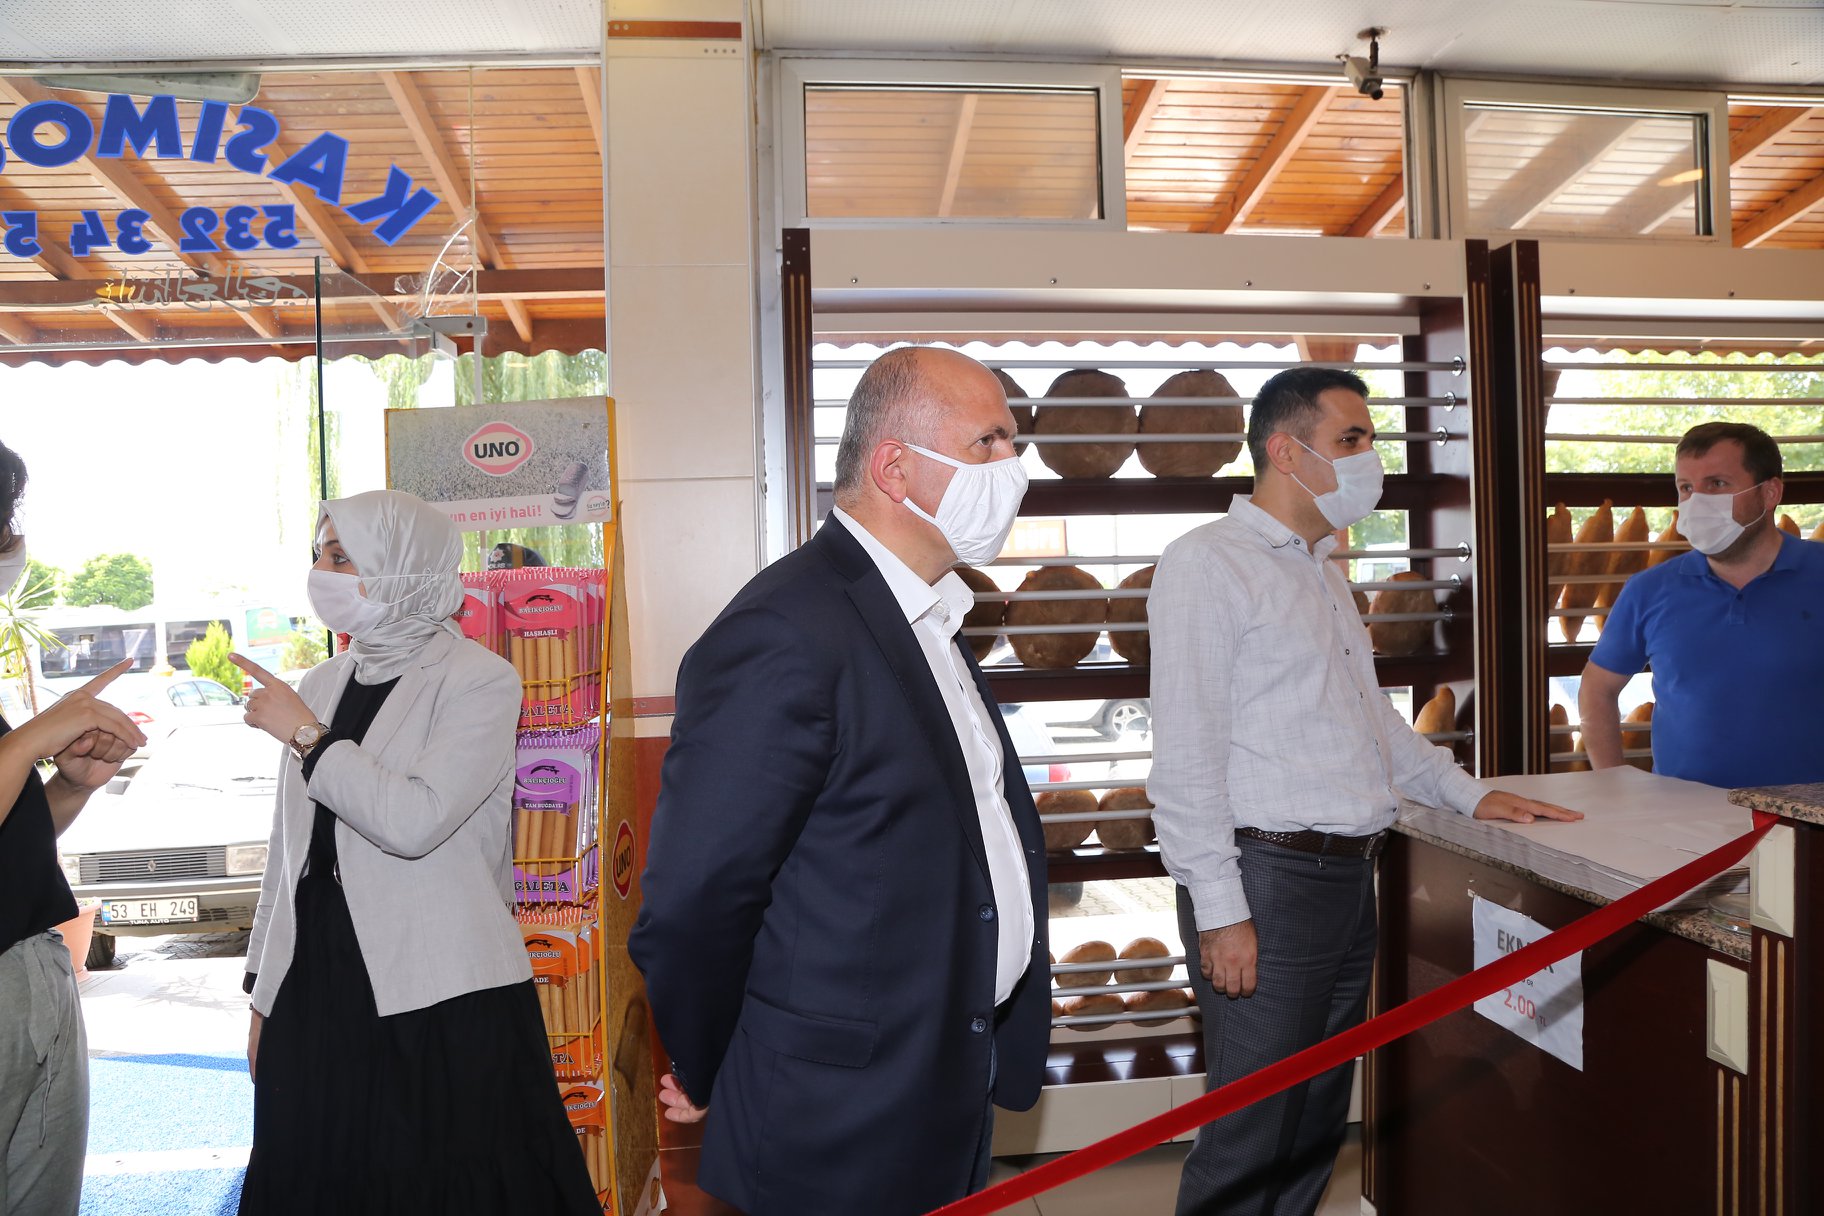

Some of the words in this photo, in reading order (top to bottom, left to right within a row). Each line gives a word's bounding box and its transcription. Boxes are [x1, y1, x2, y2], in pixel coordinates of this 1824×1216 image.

[474, 441, 520, 459] UNO
[470, 512, 487, 521] en
[490, 507, 507, 522] iyi
[510, 505, 542, 519] hali!
[616, 846, 630, 878] UNO
[111, 905, 128, 919] 53
[141, 903, 157, 917] EH
[170, 901, 196, 916] 249
[529, 951, 561, 959] IKÇIOĞLU
[1504, 988, 1536, 1020] 2.00
